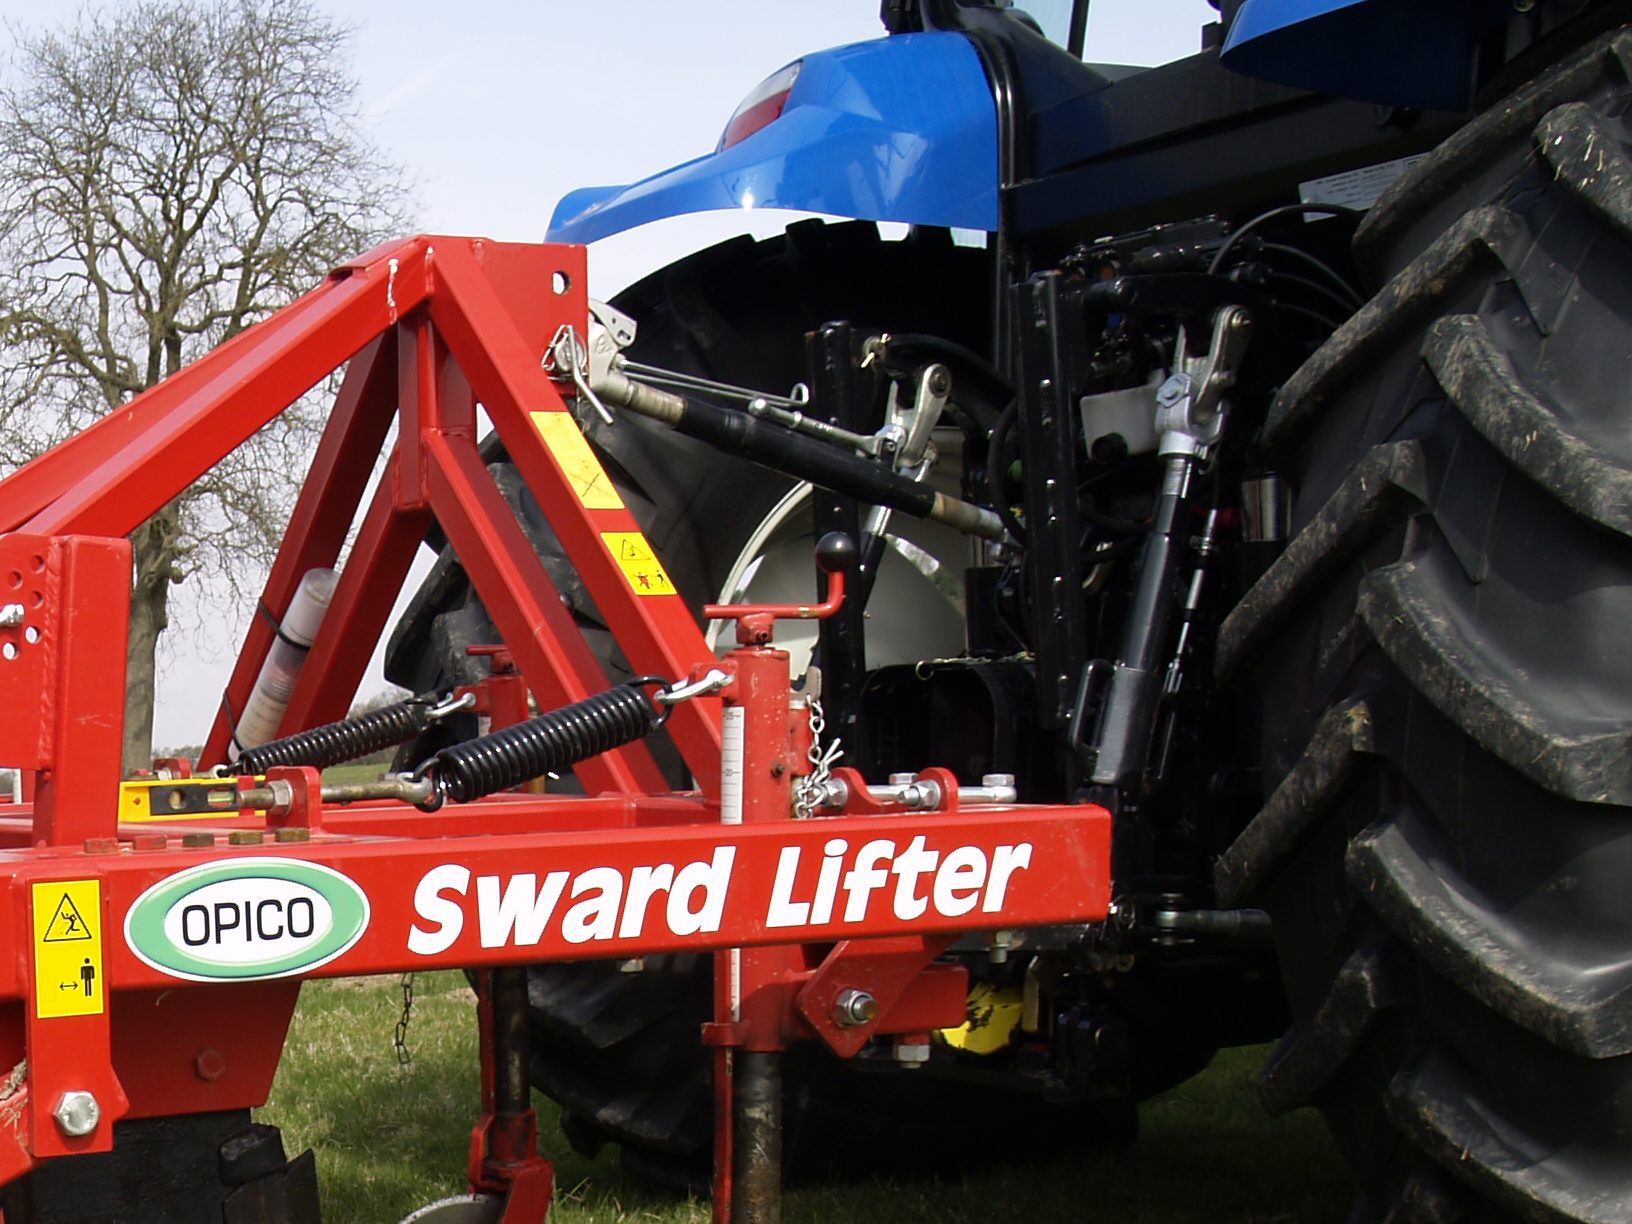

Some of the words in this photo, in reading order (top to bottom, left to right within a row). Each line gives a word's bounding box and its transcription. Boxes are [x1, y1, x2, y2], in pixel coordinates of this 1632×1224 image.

[182, 897, 315, 946] OPICO
[407, 845, 737, 955] Sward
[765, 835, 1033, 928] Lifter
